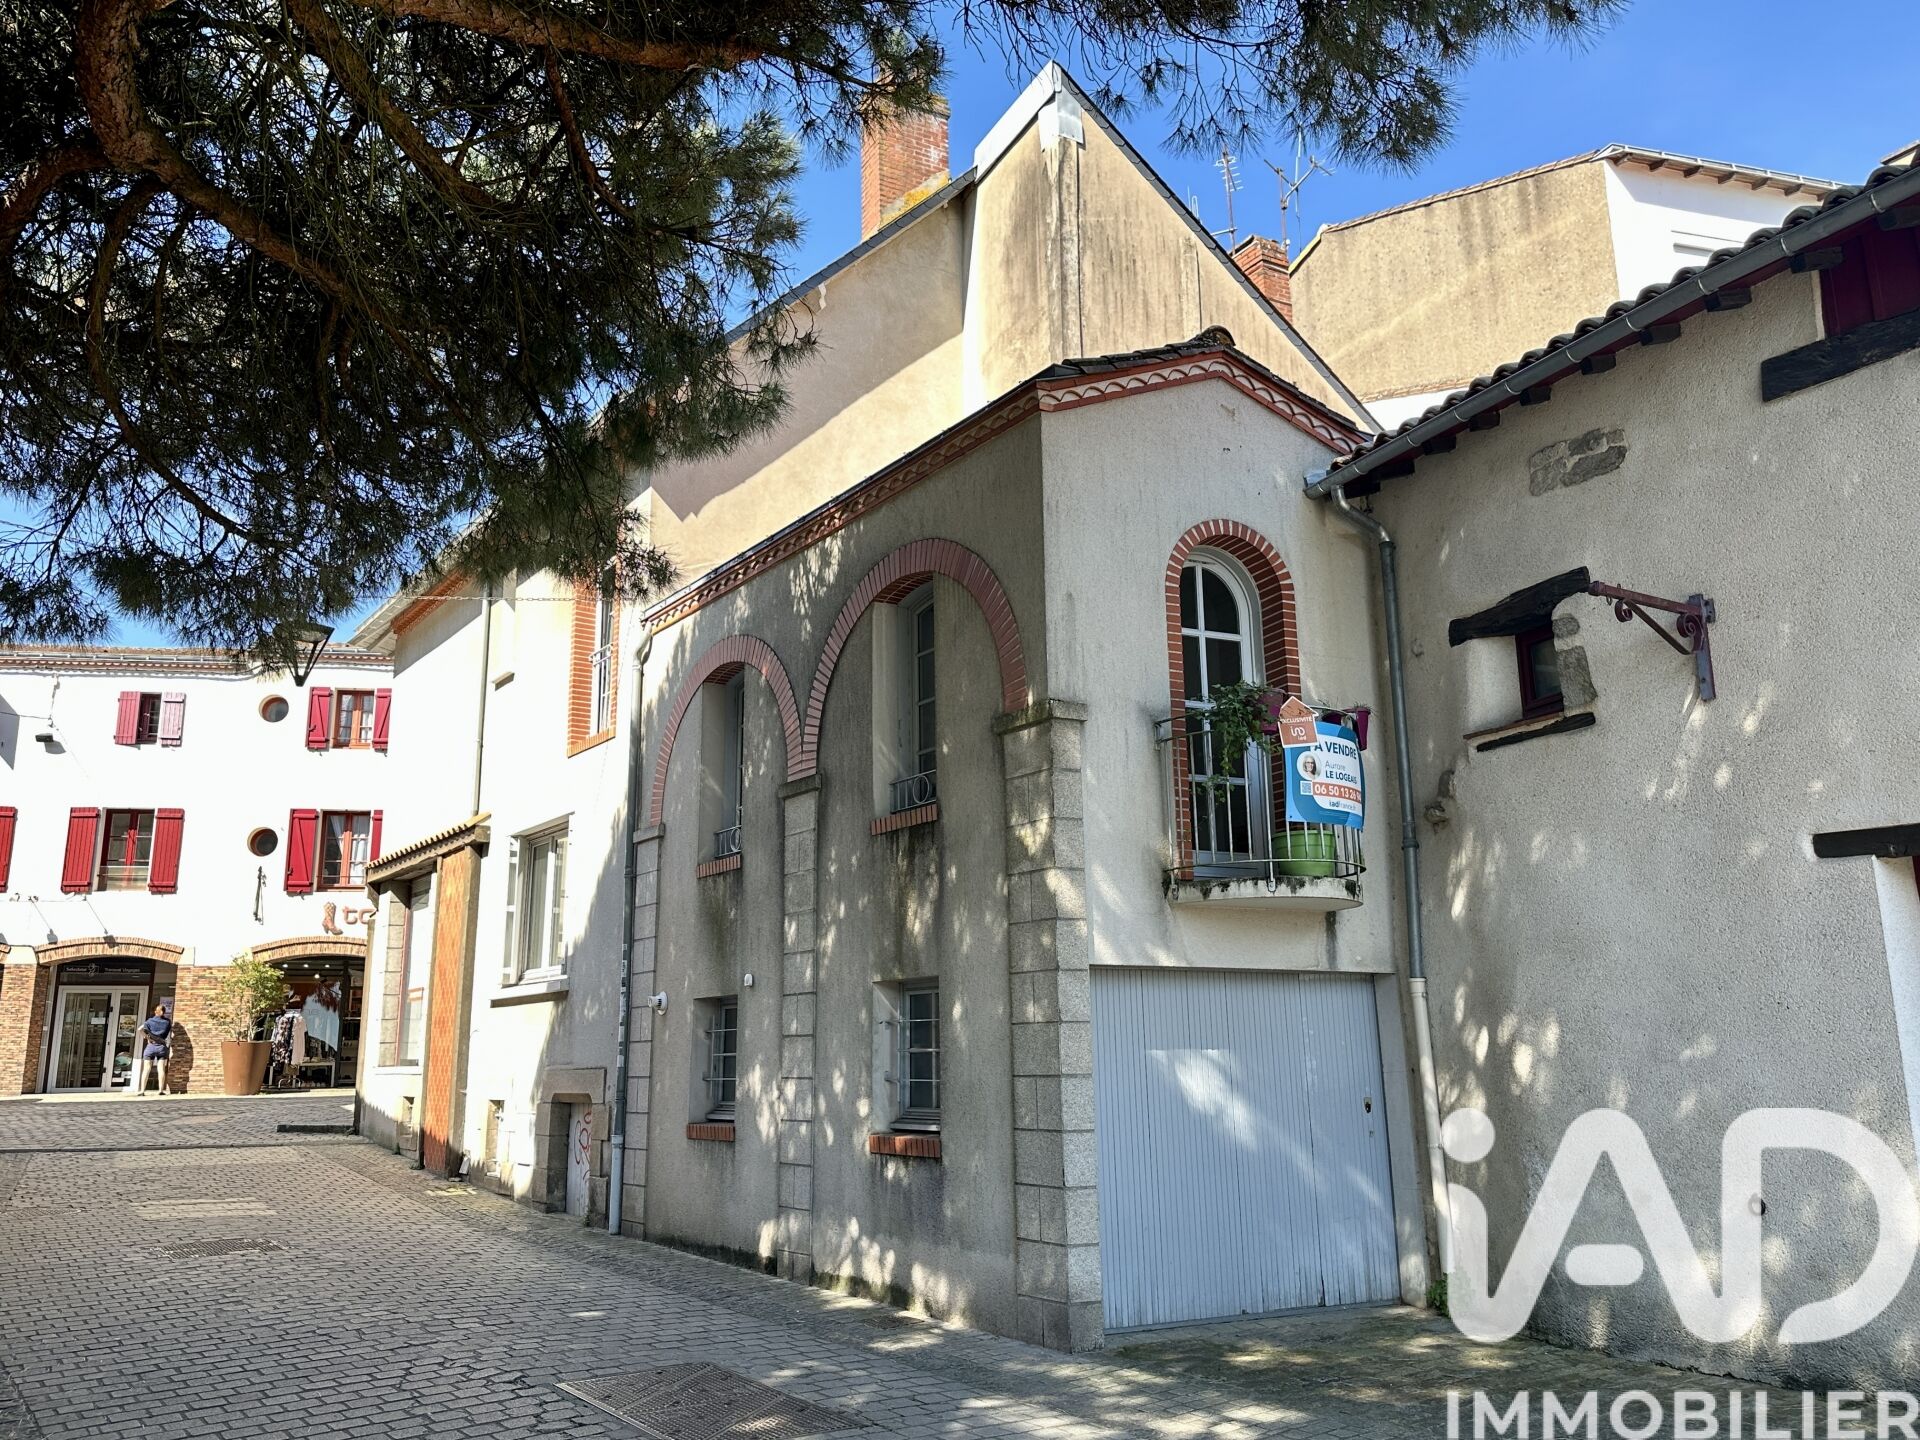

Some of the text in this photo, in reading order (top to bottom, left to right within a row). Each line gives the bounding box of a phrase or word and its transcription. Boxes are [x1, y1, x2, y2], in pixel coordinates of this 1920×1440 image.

[1325, 741, 1356, 760] VENDRE
[1325, 770, 1334, 779] LE
[1314, 783, 1327, 795] 06
[1328, 785, 1339, 796] 50
[1340, 787, 1349, 798] 13
